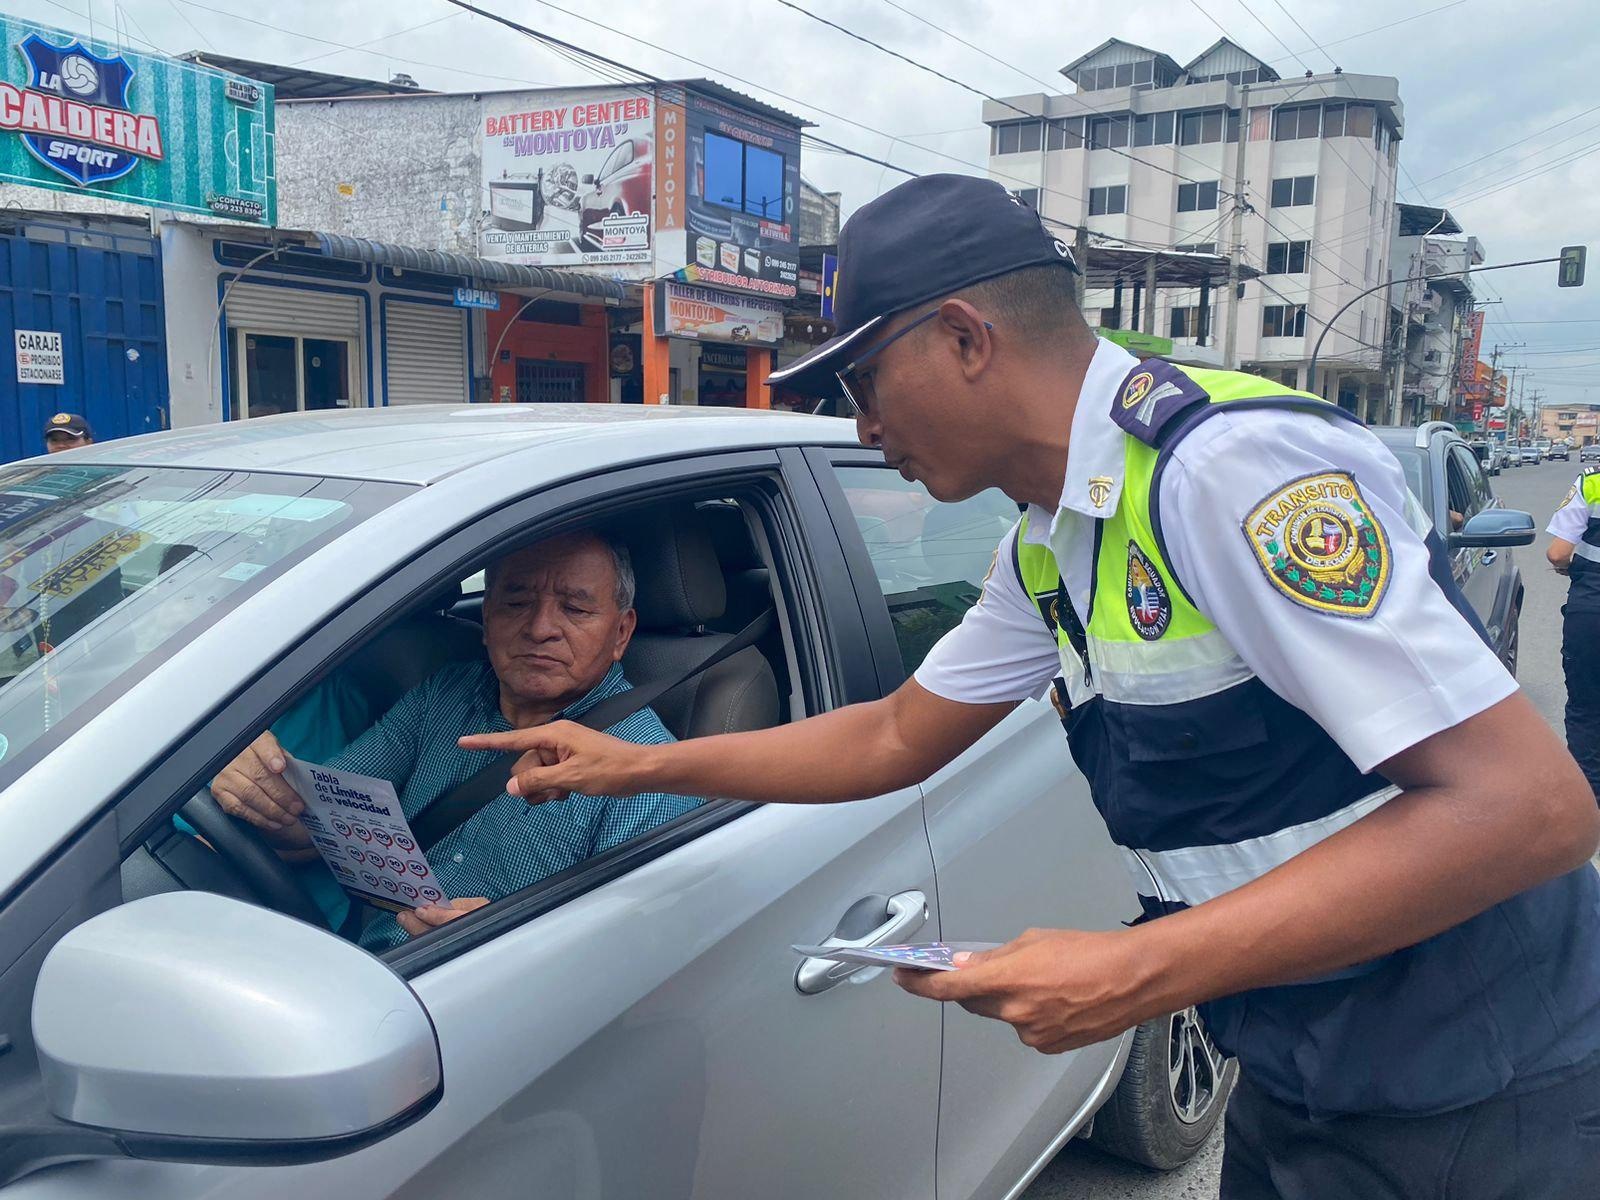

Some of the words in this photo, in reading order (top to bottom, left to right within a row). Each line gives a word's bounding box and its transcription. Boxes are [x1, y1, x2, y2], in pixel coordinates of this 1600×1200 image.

[39, 71, 61, 91] LA
[0, 84, 163, 160] CALDERA
[486, 107, 568, 137] BATTERY
[572, 97, 650, 127] CENTER
[503, 123, 628, 157] “MONTOYA”
[47, 141, 118, 169] SPORT
[664, 111, 677, 227] MONTOYA
[486, 233, 507, 243] VENTA
[508, 232, 514, 243] Y
[514, 230, 570, 243] MANTENIMIENTO
[604, 225, 646, 236] MONTOYA
[505, 243, 515, 254] DE
[457, 287, 498, 306] COPIAS
[669, 284, 695, 299] TALLER
[696, 287, 705, 300] DE
[670, 301, 715, 321] MONTOYA
[19, 334, 59, 351] GARAJE
[31, 354, 61, 366] PROHIBIDO
[20, 368, 62, 380] ESTACIONARSE
[1256, 482, 1352, 538] TRANSITO
[1305, 556, 1325, 567] DEL
[1144, 562, 1166, 598] ECUADOR
[310, 769, 340, 785] Tabla
[314, 782, 328, 793] de
[319, 793, 333, 804] de
[335, 797, 391, 816] velocidad
[374, 832, 389, 841] 100
[423, 889, 436, 897] 40
